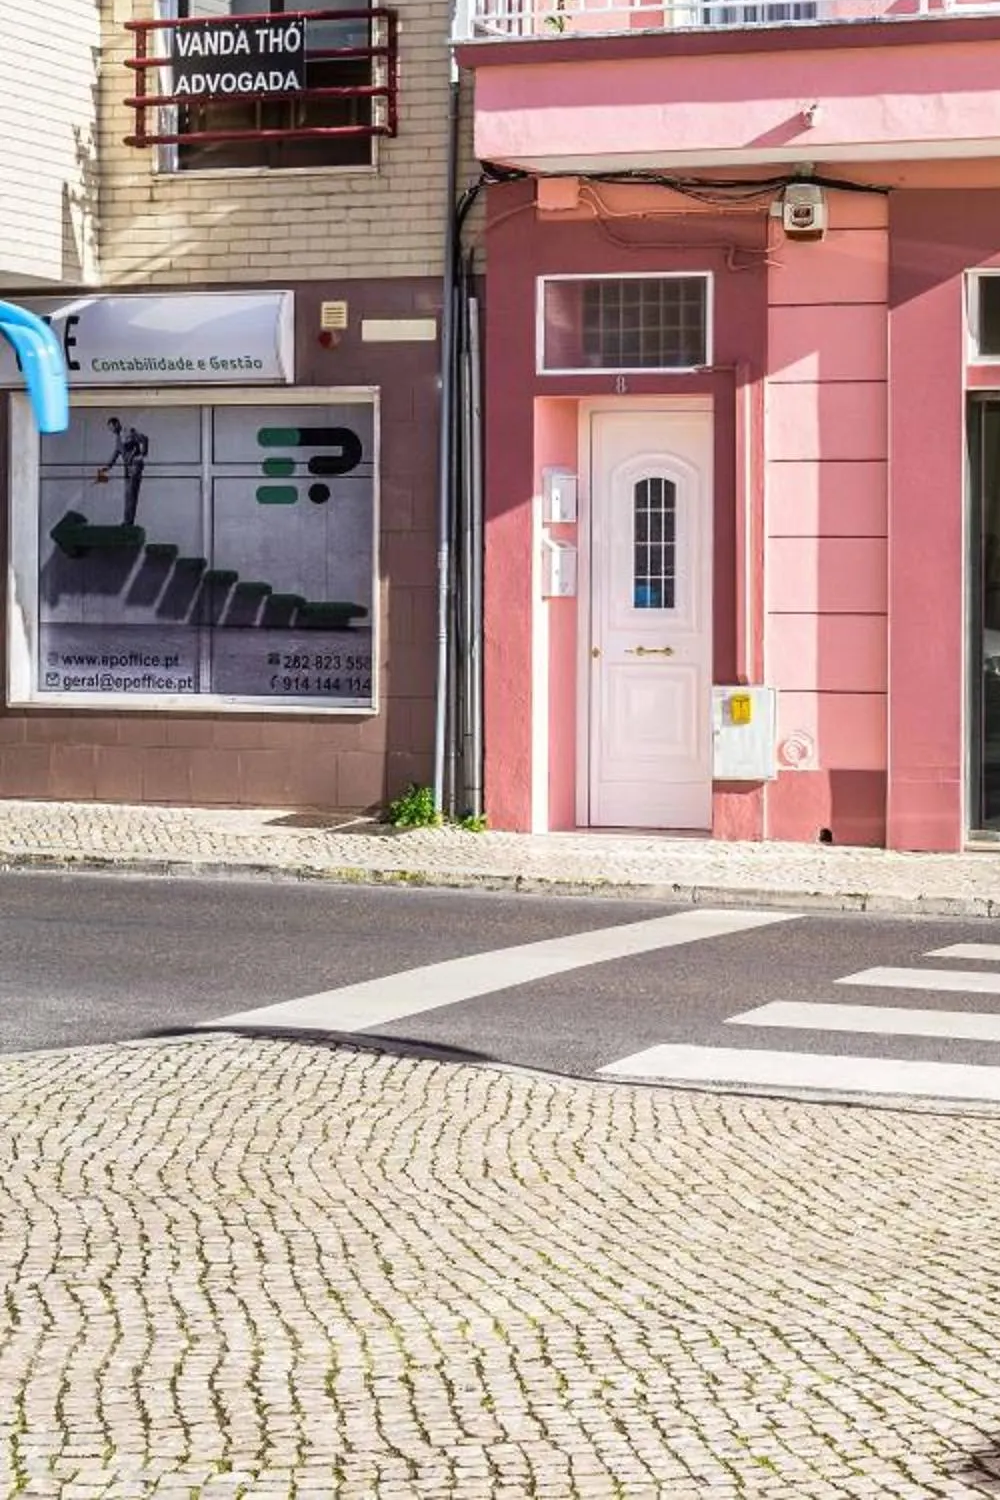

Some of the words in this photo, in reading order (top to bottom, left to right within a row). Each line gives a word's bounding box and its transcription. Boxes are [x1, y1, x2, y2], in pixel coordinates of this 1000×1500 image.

[176, 30, 250, 57] VANDA
[255, 22, 301, 53] THÓ
[174, 70, 300, 96] ADVOGADA
[91, 357, 194, 371] Contabilidade
[198, 360, 206, 370] e
[209, 355, 263, 371] Gestão
[62, 653, 179, 669] www.epoffice.pt
[63, 674, 193, 690] geral@epoffice.pt
[283, 676, 309, 690] 914
